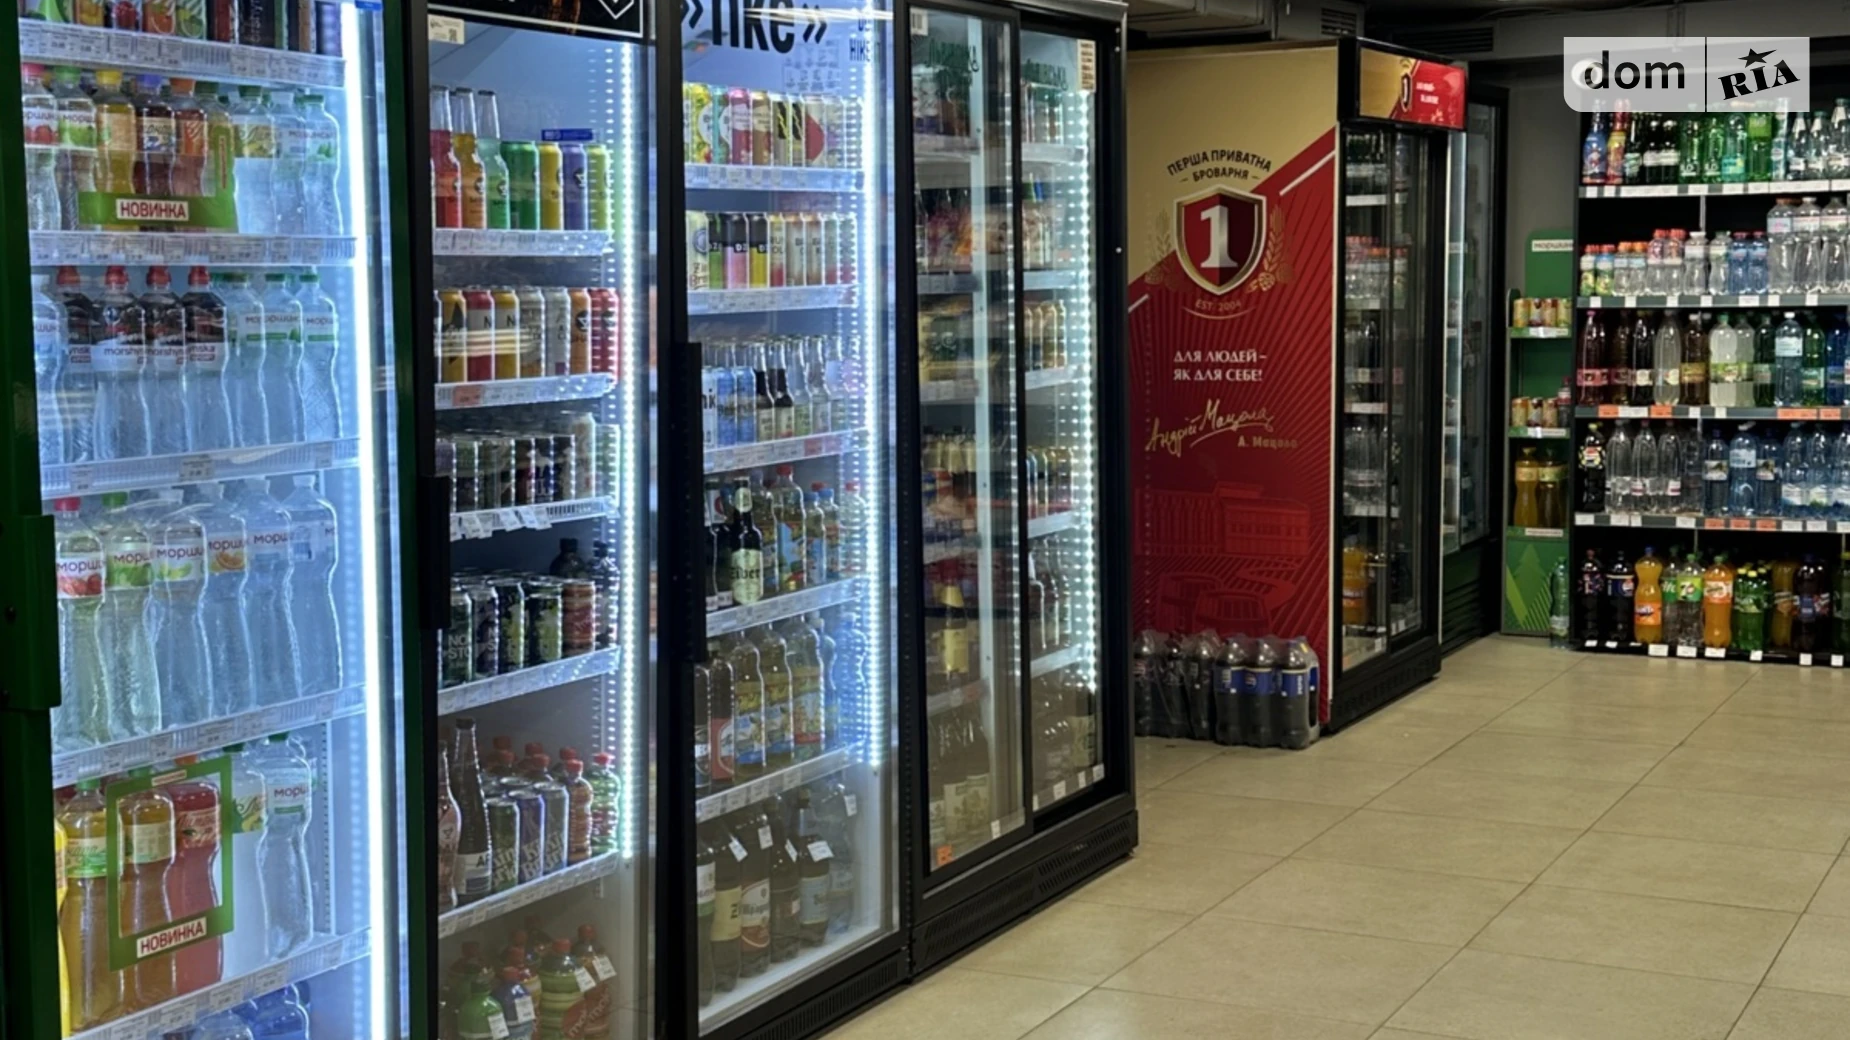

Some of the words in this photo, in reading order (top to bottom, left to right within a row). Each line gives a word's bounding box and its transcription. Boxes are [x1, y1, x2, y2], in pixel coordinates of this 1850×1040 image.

[1167, 151, 1209, 176] ПЕРША
[1211, 149, 1272, 172] ПРИВАТНА
[1192, 167, 1249, 182] БРОВАРНЯ
[120, 200, 187, 219] НОВИНКА
[1201, 205, 1238, 268] 1
[1173, 351, 1202, 362] ДЛЯ
[1173, 369, 1191, 381] ЯК
[1194, 369, 1222, 381] ДЛЯ
[1225, 368, 1263, 382] СЕБЕ!
[140, 921, 206, 953] НОВИНКА
